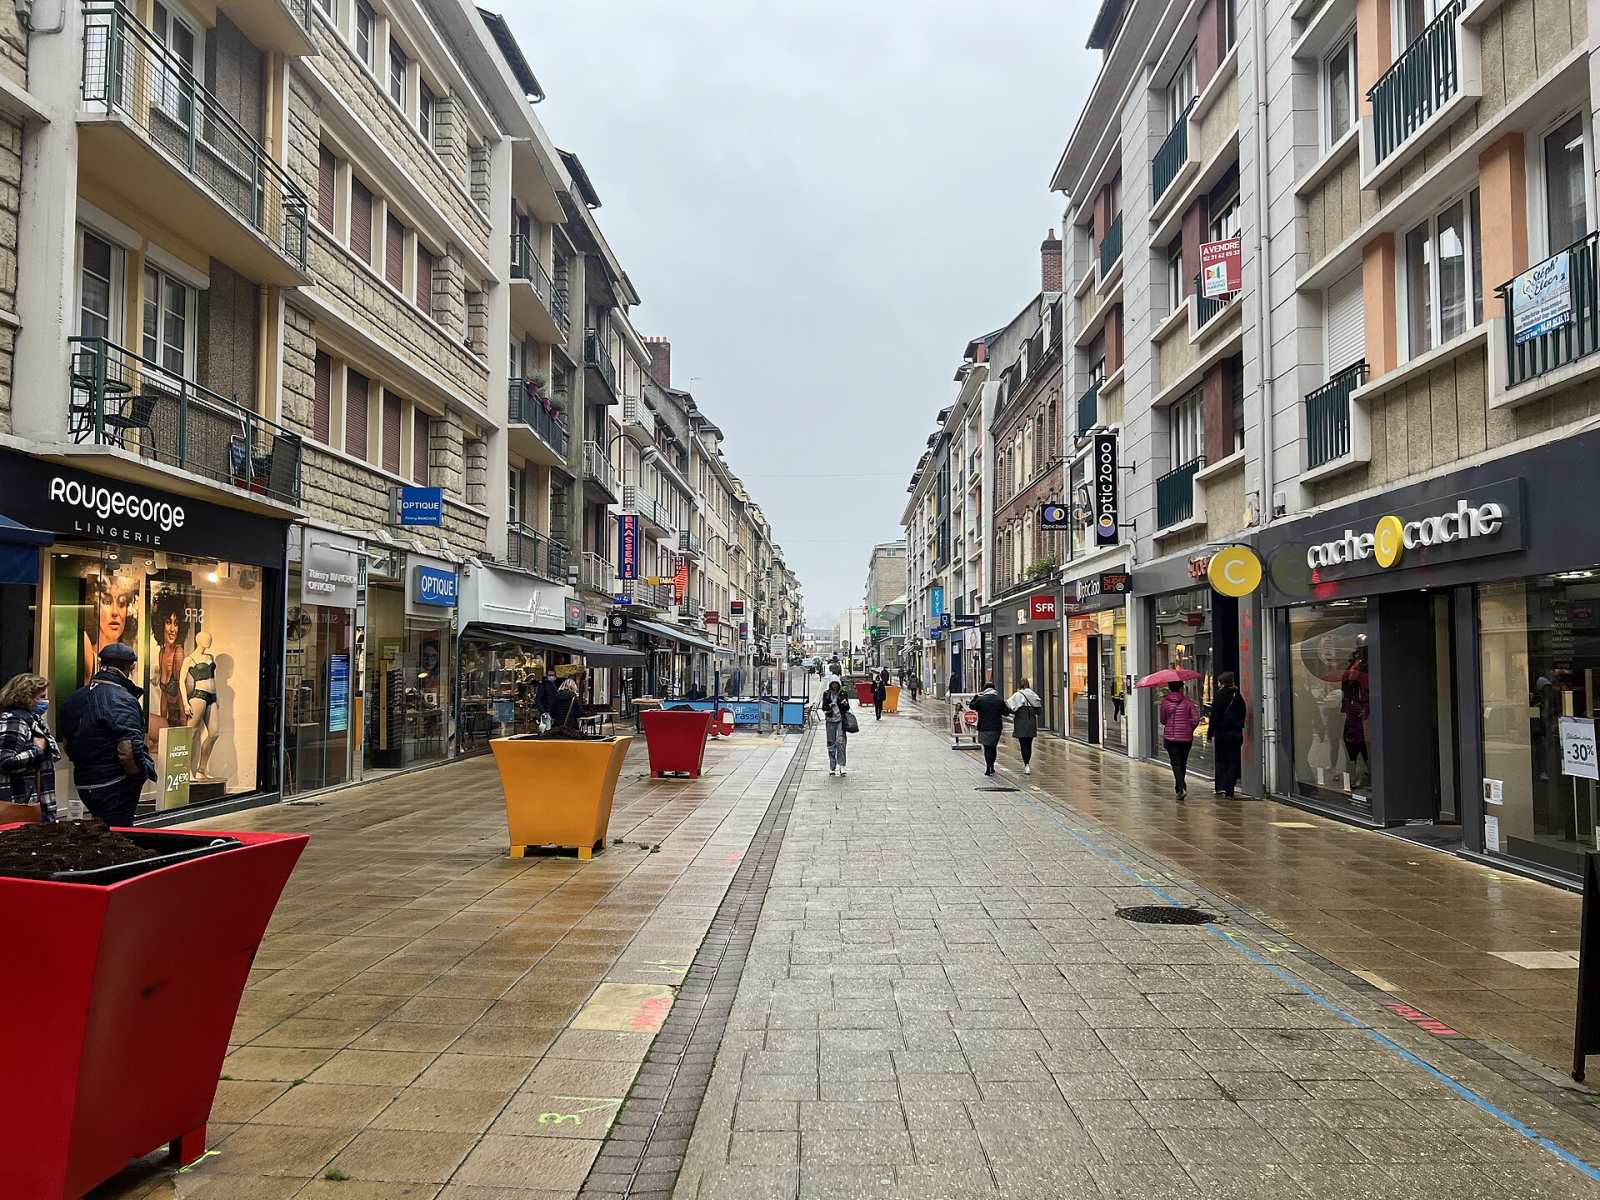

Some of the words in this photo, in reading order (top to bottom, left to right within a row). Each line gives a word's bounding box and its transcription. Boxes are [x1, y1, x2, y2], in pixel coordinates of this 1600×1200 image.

[1203, 247, 1210, 256] A
[1210, 242, 1240, 253] VENDRE
[402, 501, 440, 510] OPTIQUE
[74, 520, 161, 545] LINGERIE
[1307, 529, 1375, 569] cache
[1403, 499, 1503, 550] cache
[624, 515, 634, 578] BRASSERIE
[421, 576, 454, 597] OPTIQUE
[1035, 603, 1055, 613] SFR
